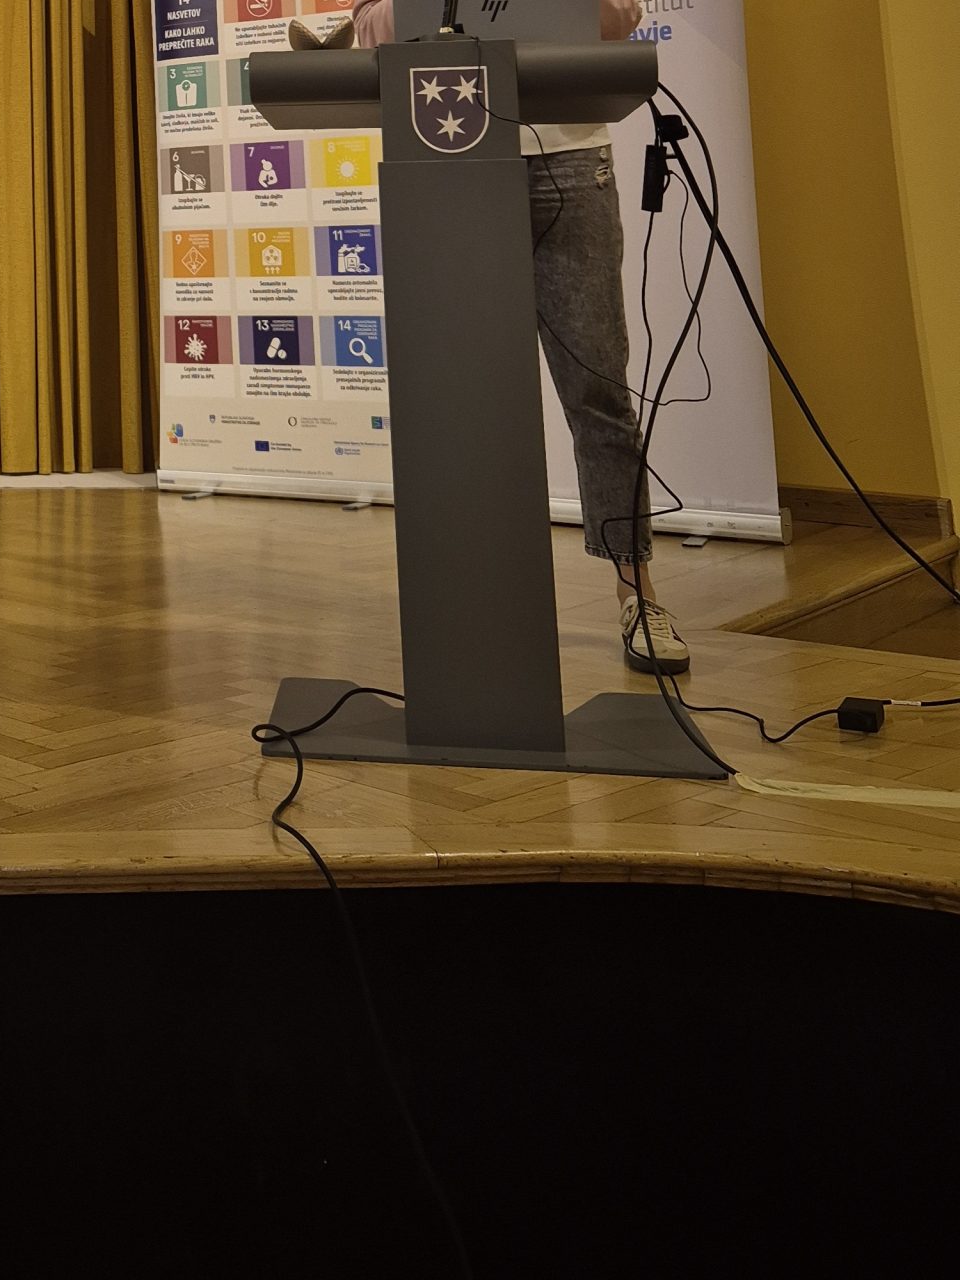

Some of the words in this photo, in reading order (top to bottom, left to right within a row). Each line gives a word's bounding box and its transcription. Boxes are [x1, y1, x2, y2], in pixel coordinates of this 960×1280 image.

[167, 8, 201, 21] NASVETOV
[164, 27, 182, 39] KAKO
[182, 24, 205, 37] LAHKO
[158, 37, 195, 53] PREPREČITE
[195, 35, 215, 48] RAKA
[169, 68, 176, 79] 3
[247, 146, 255, 158] 7
[327, 141, 336, 153] 8
[172, 151, 179, 162] 6
[175, 234, 182, 245] 9
[252, 231, 266, 243] 10
[332, 229, 343, 241] 11
[177, 319, 190, 331] 12
[256, 319, 269, 331] 13
[338, 319, 351, 331] 14
